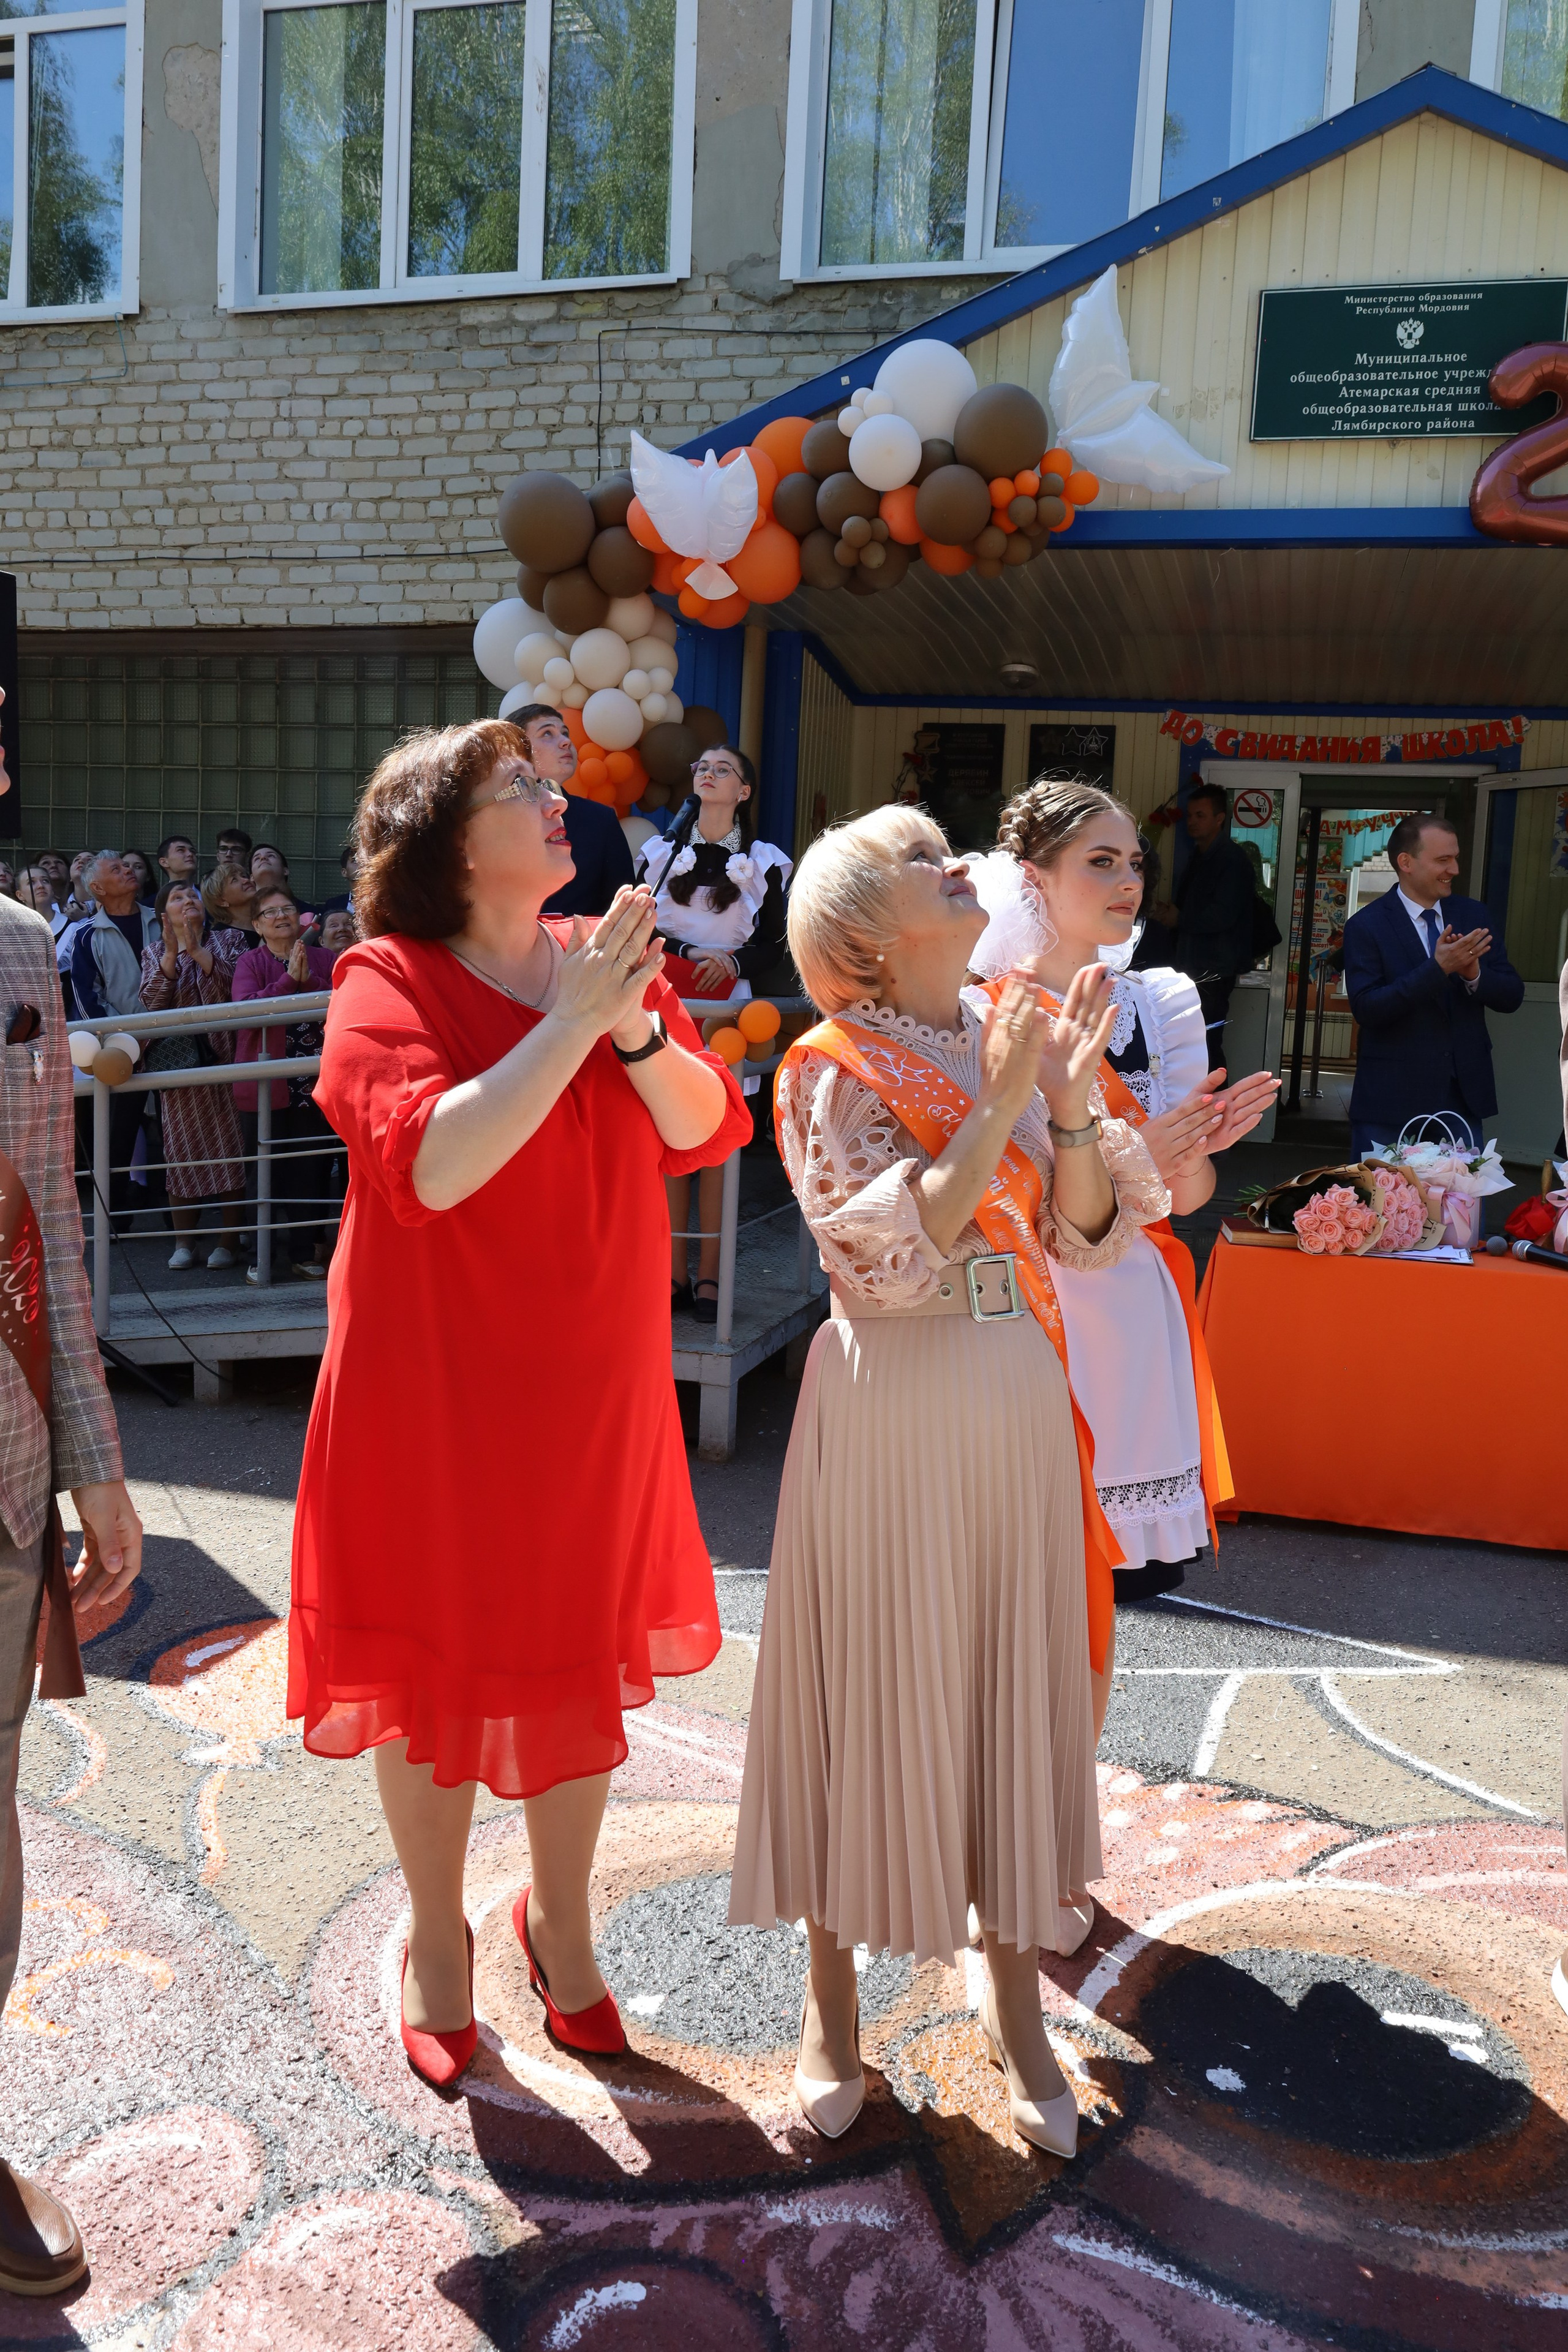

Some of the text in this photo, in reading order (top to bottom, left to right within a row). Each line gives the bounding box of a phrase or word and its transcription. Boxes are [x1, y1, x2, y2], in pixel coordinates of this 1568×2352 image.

[1344, 292, 1483, 304] Министерство образования
[1355, 304, 1470, 316] Республики Мордовия
[1354, 353, 1468, 368] Муниципальное
[1290, 369, 1492, 385] общеобразовательное учреж
[1338, 385, 1481, 400] Атемарская средняя
[1302, 402, 1452, 417] общеобразовательная
[1331, 418, 1476, 433] Лямбирского района
[1159, 709, 1204, 746] ДО
[1402, 715, 1525, 762] ШКОЛА!
